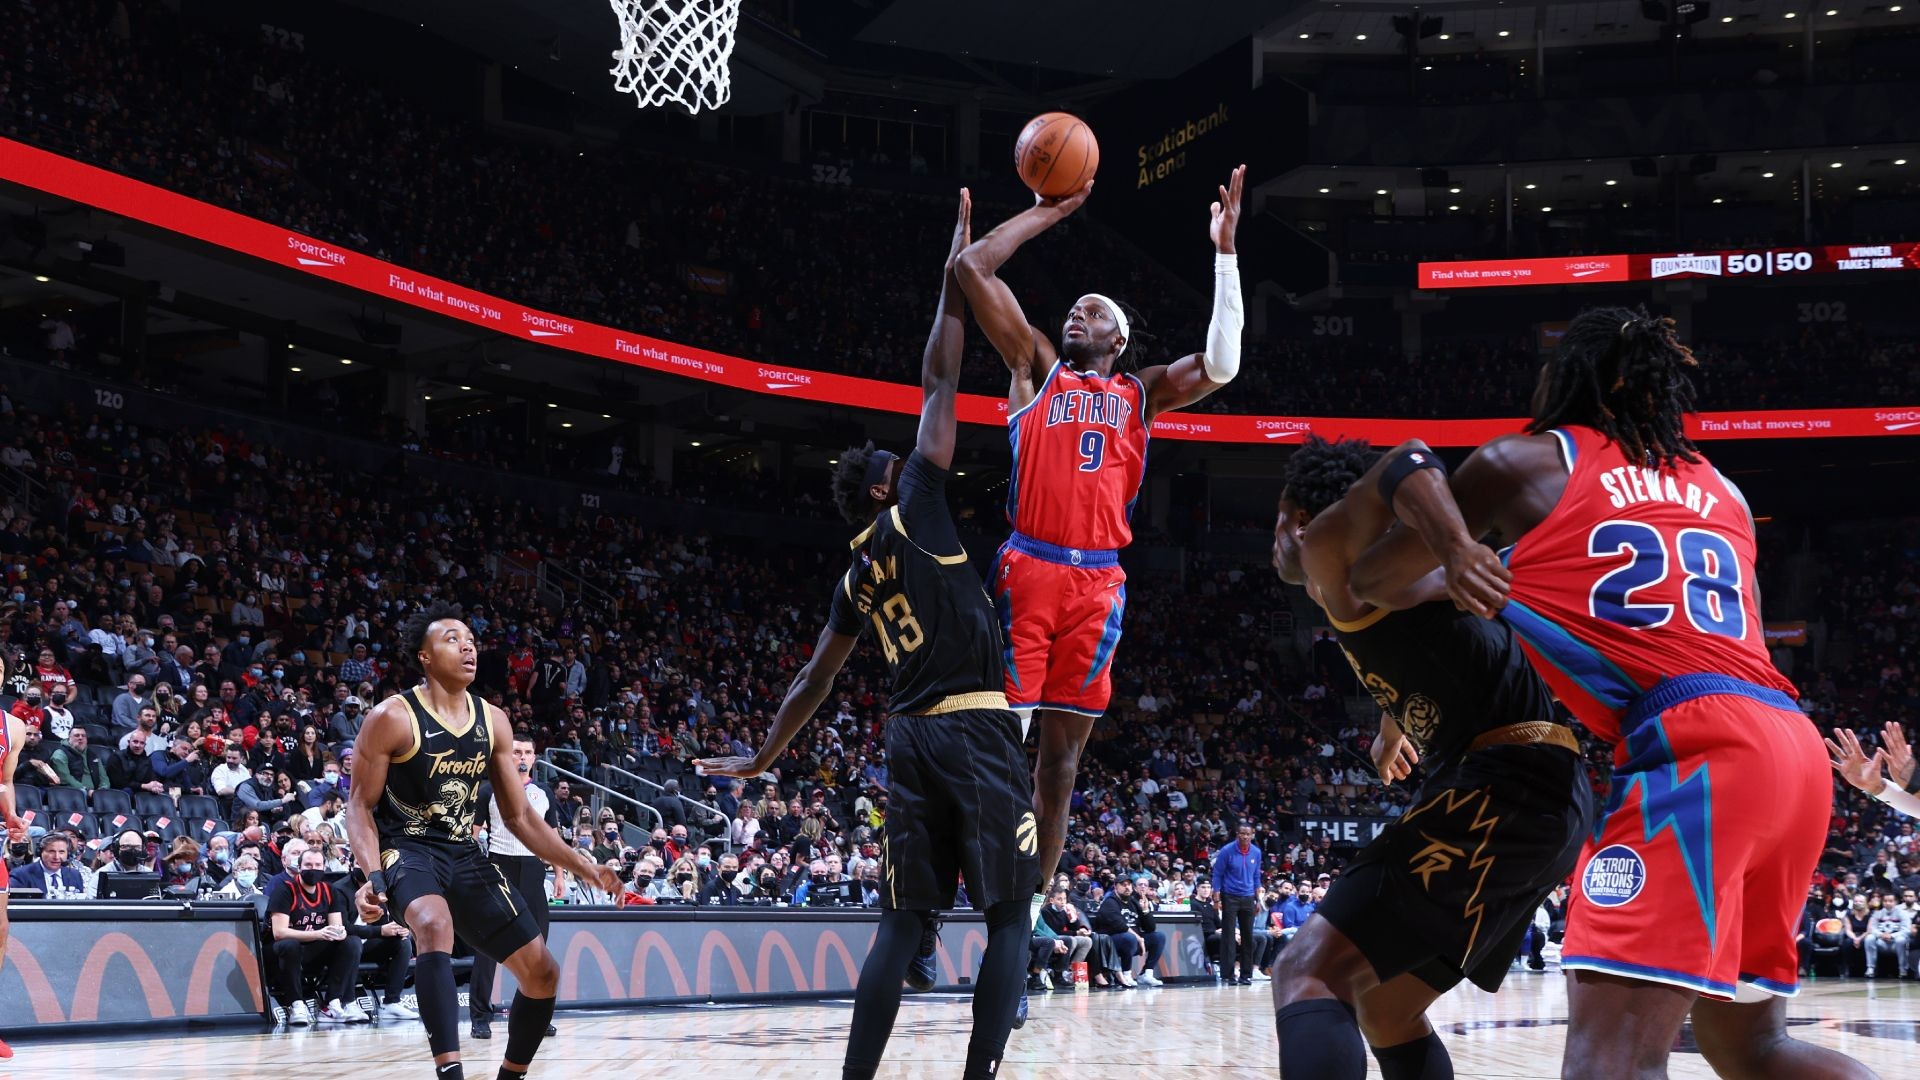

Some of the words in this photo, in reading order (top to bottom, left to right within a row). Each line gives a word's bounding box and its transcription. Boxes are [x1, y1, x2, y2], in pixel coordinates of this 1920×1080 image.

[1137, 101, 1229, 167] Scotiabank
[812, 163, 852, 185] 324
[1137, 152, 1186, 190] Arena
[288, 237, 346, 264] SPORTCHEK
[1849, 246, 1892, 257] WINNER
[1431, 270, 1454, 279] Find
[1455, 269, 1479, 278] what
[1482, 269, 1511, 277] moves
[1513, 268, 1531, 278] you
[1655, 259, 1718, 274] FOUNDATION
[1837, 259, 1870, 270] TAKES
[1872, 257, 1904, 268] HOME
[389, 274, 414, 293] Find
[417, 286, 445, 302] what
[447, 296, 480, 313] moves
[481, 306, 501, 320] you
[1797, 301, 1848, 322] 302
[522, 312, 574, 334] SPORTCHEK
[1312, 316, 1354, 336] 301
[615, 339, 640, 355] Find
[642, 347, 668, 362] what
[671, 354, 703, 369] moves
[704, 361, 724, 374] you
[757, 367, 811, 384] SPORTCHEK
[94, 389, 123, 409] 120
[1046, 390, 1132, 438] DETROIT
[1153, 421, 1188, 431] moves
[1190, 423, 1212, 434] you
[1256, 420, 1309, 430] SPORTCHEK
[1701, 420, 1729, 431] Find
[1731, 419, 1762, 430] what
[1766, 420, 1805, 429] moves
[1807, 420, 1831, 430] you
[1079, 430, 1105, 472] 9
[581, 494, 600, 508] 121
[1600, 465, 1719, 519] STEWART
[1588, 520, 1747, 640] 28
[871, 593, 924, 665] 43
[425, 749, 486, 779] Toronto
[470, 781, 480, 803] 4
[1300, 821, 1359, 841] THE
[1593, 858, 1637, 873] DETROIT
[1590, 872, 1634, 888] PISTONS
